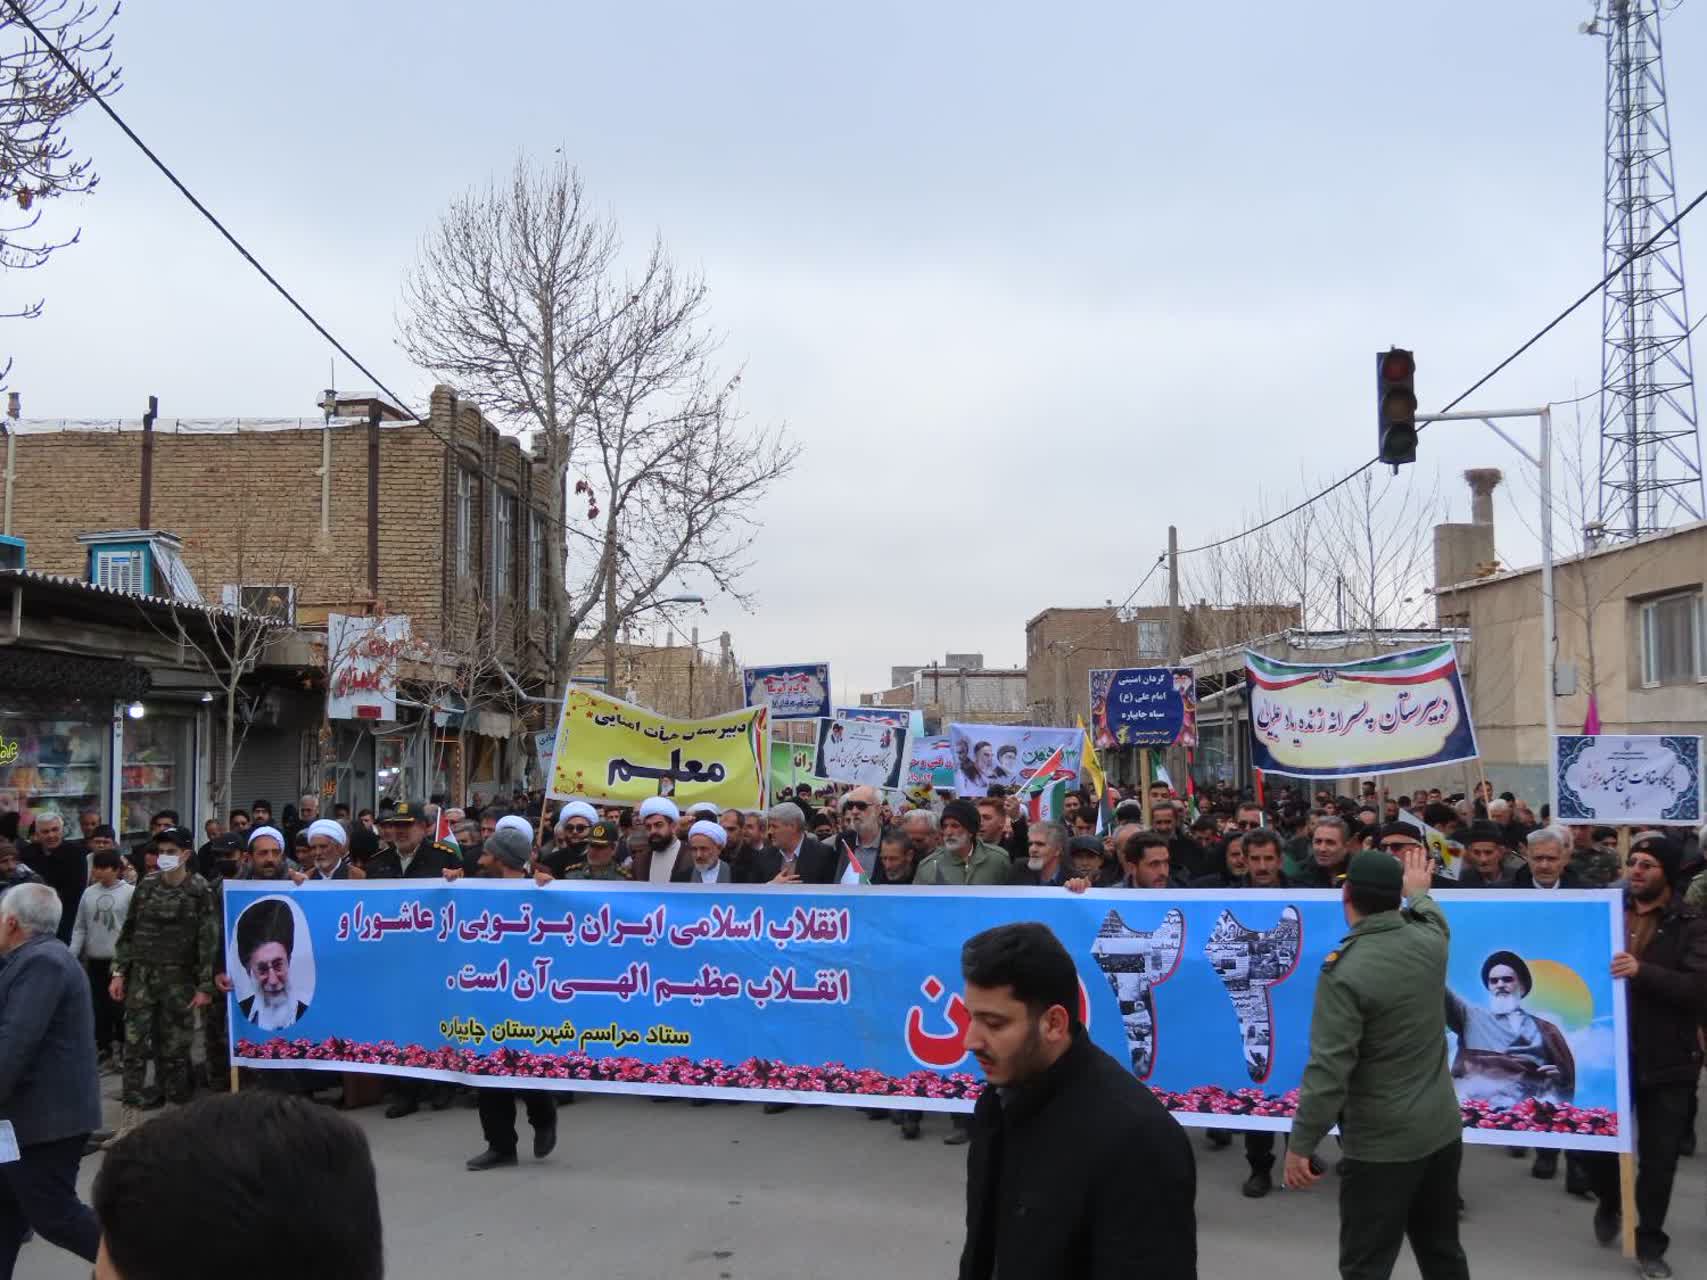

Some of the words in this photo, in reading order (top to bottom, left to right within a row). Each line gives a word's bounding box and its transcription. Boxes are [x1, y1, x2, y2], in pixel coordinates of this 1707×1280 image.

[1135, 693, 1150, 703] علی
[1151, 692, 1167, 702] امام
[1379, 690, 1451, 734] دبیرستان
[1327, 698, 1378, 736] پسرانه
[607, 748, 726, 786] معلم
[336, 913, 349, 941] و
[354, 901, 435, 941] عاشورا
[438, 902, 454, 941] از
[459, 904, 575, 946] پرتویی
[581, 904, 665, 944] ایران
[669, 905, 763, 947] اسلامی
[769, 906, 849, 949] انقلاب
[512, 956, 552, 1001] آن
[551, 961, 650, 1003] الهی
[654, 965, 740, 1004] عظیم
[747, 966, 849, 1008] انقلاب
[440, 1016, 486, 1043] چایپاره
[491, 1018, 576, 1045] شهرستان
[580, 1022, 640, 1050] مراسم
[646, 1024, 690, 1046] ستاد
